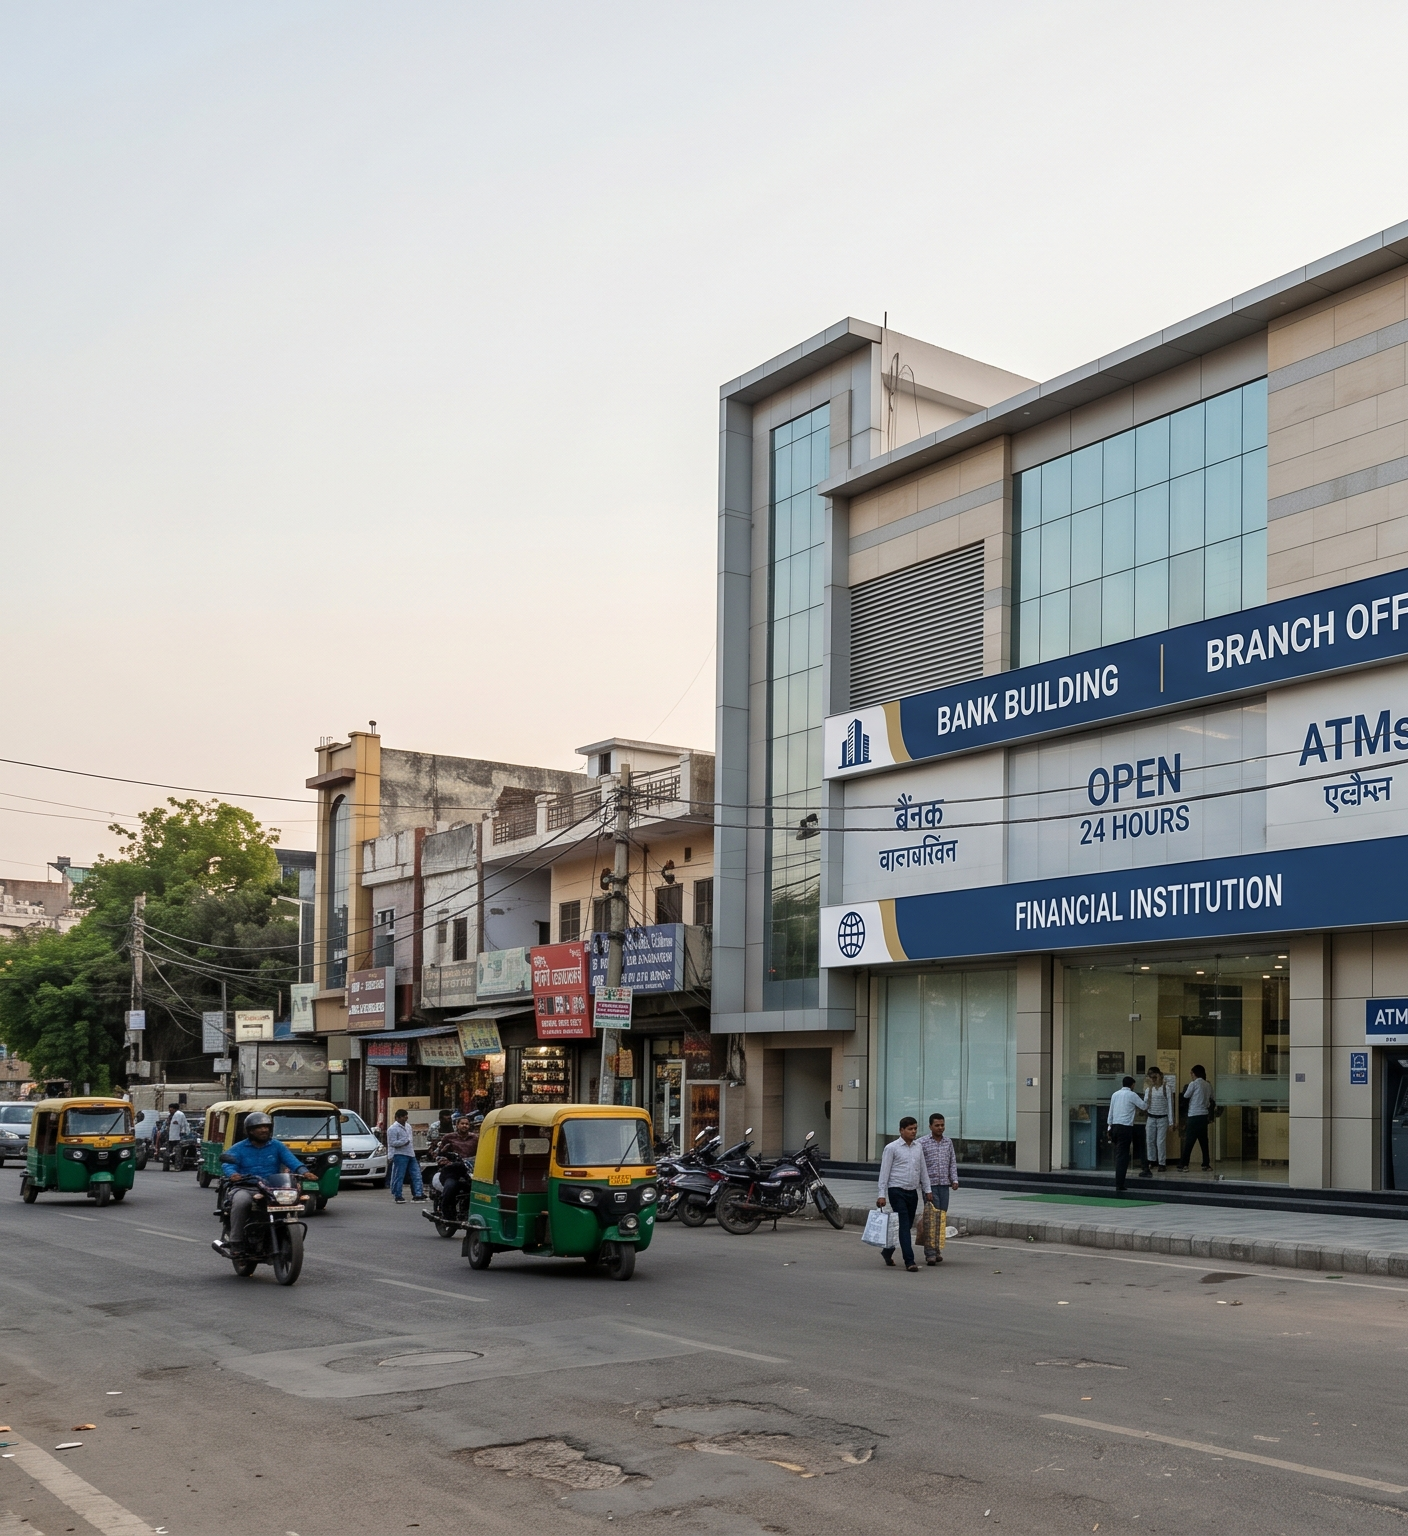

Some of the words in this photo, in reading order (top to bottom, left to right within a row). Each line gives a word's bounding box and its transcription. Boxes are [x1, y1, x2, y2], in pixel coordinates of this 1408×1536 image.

[1206, 610, 1335, 673] BRANCH
[937, 693, 998, 736] BANK
[1005, 663, 1120, 720] BUILDING
[1087, 752, 1182, 807] OPEN
[1080, 816, 1106, 846] 24
[1111, 804, 1191, 841] HOURS
[1015, 893, 1123, 931] FINANCIAL
[1129, 873, 1283, 921] INSTITUTION
[1374, 1008, 1408, 1026] ATM
